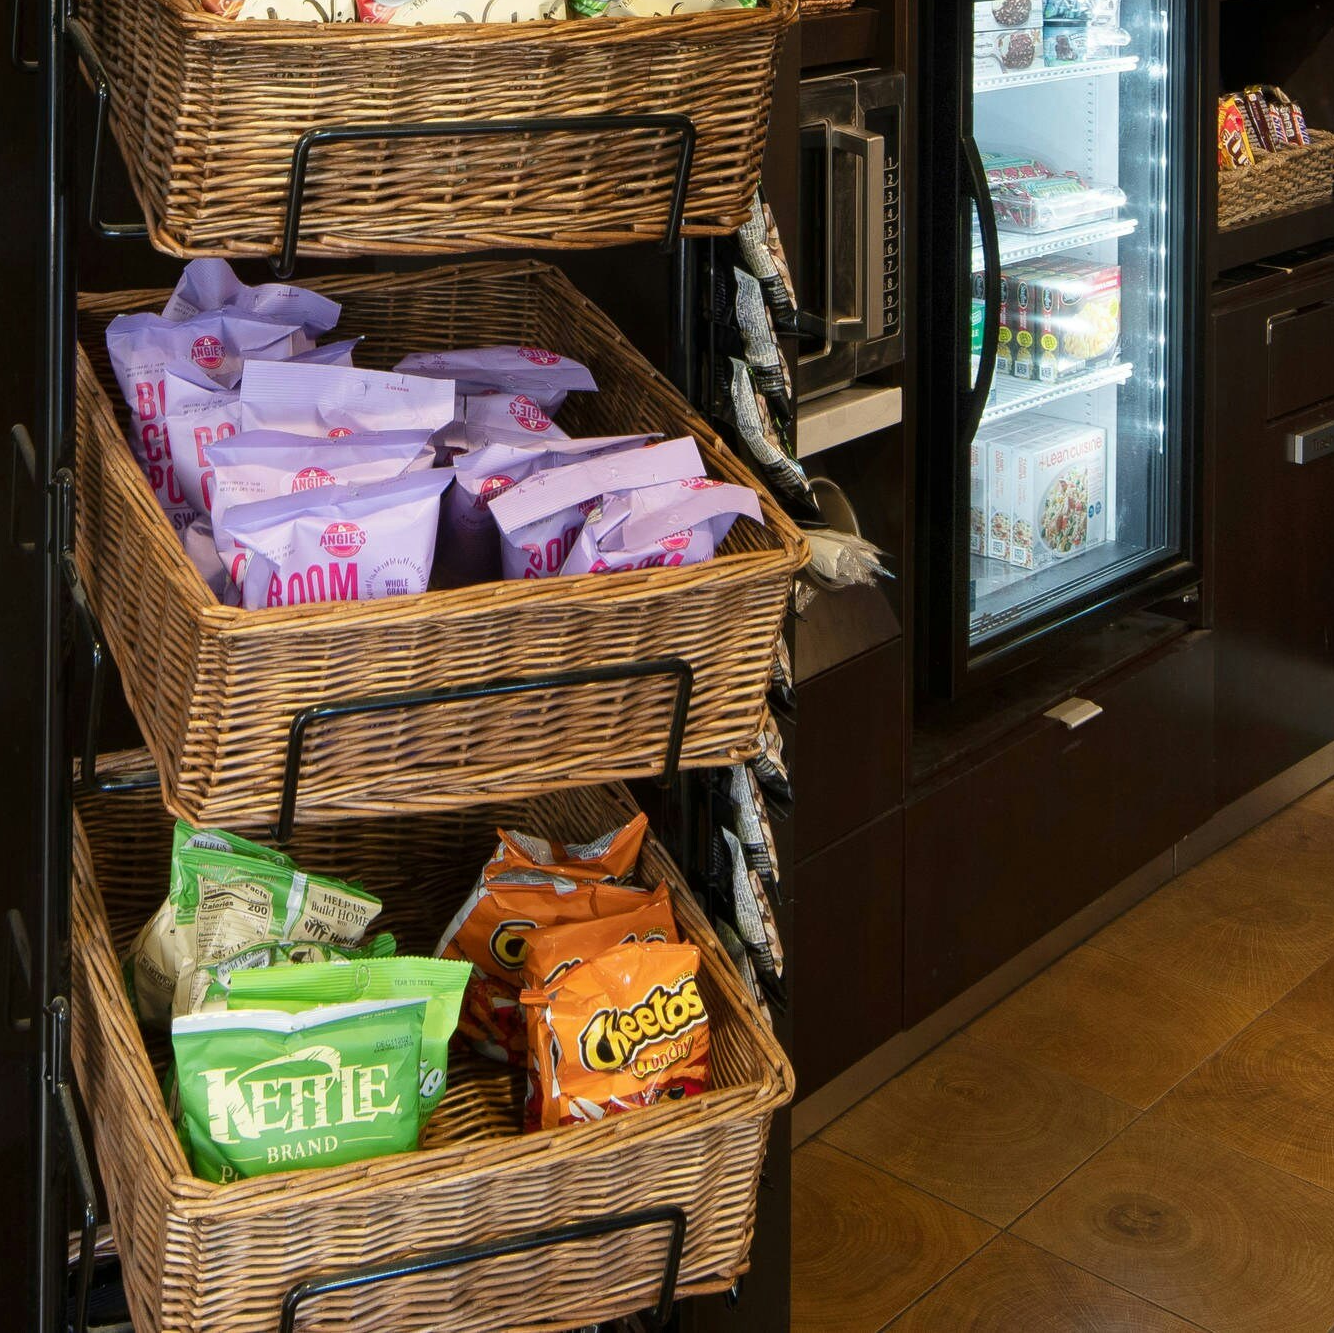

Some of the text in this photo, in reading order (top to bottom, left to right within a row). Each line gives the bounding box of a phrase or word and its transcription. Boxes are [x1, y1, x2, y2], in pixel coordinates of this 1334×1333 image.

[190, 345, 227, 360] ANGIE'S
[507, 402, 550, 420] NGIE'S
[1046, 435, 1104, 468] Lean cuisine
[319, 531, 367, 547] ANGIE'S
[267, 562, 359, 608] BOOM
[384, 577, 409, 588] WHOLE
[386, 587, 408, 596] GRAIN
[245, 882, 268, 900] Facts
[201, 899, 235, 911] Calories
[246, 903, 268, 916] 200
[310, 900, 370, 928] Build HOME
[322, 893, 368, 916] HELP US
[583, 977, 706, 1071] Cheetos
[631, 1035, 694, 1078] Crunchy
[197, 1045, 402, 1145] KETTLE
[267, 1135, 339, 1165] BRAND
